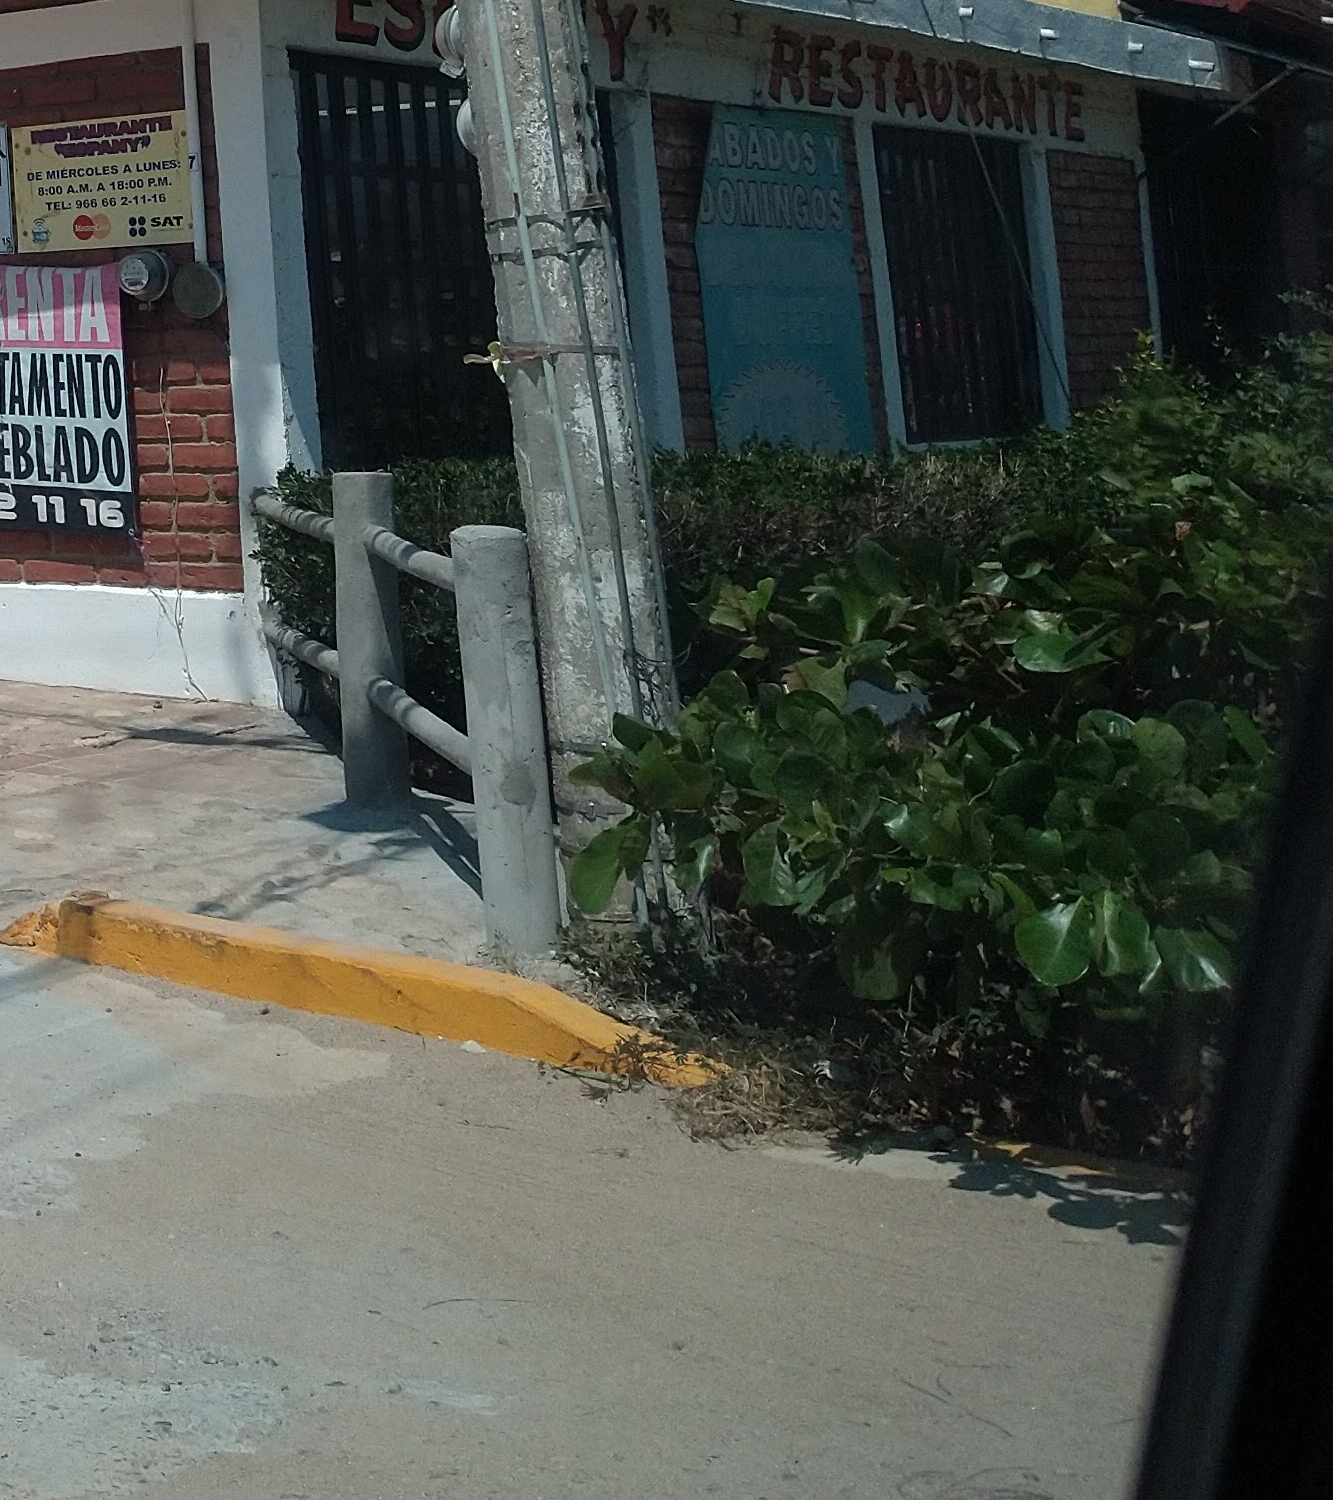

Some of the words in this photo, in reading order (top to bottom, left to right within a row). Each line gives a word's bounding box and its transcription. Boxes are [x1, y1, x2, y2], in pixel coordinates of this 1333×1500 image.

[767, 24, 1086, 142] RESTAURANTE
[30, 115, 173, 144] RESTAURANTE
[27, 171, 42, 181] DE
[46, 165, 119, 180] MIÉRCOLES
[122, 163, 132, 174] A
[136, 159, 181, 173] LUNES:
[37, 185, 63, 197] 8:00
[66, 183, 93, 194] A.M.
[96, 182, 105, 192] A
[110, 178, 144, 191] 18:00
[148, 176, 172, 188] P.M.
[45, 201, 71, 211] TEL:
[75, 199, 97, 209] 966
[101, 198, 116, 207] 66
[121, 193, 166, 206] 2-11-16
[699, 178, 844, 232] DOMINGOS
[150, 216, 183, 228] SAT
[32, 495, 66, 524] 11
[80, 498, 125, 528] 16
